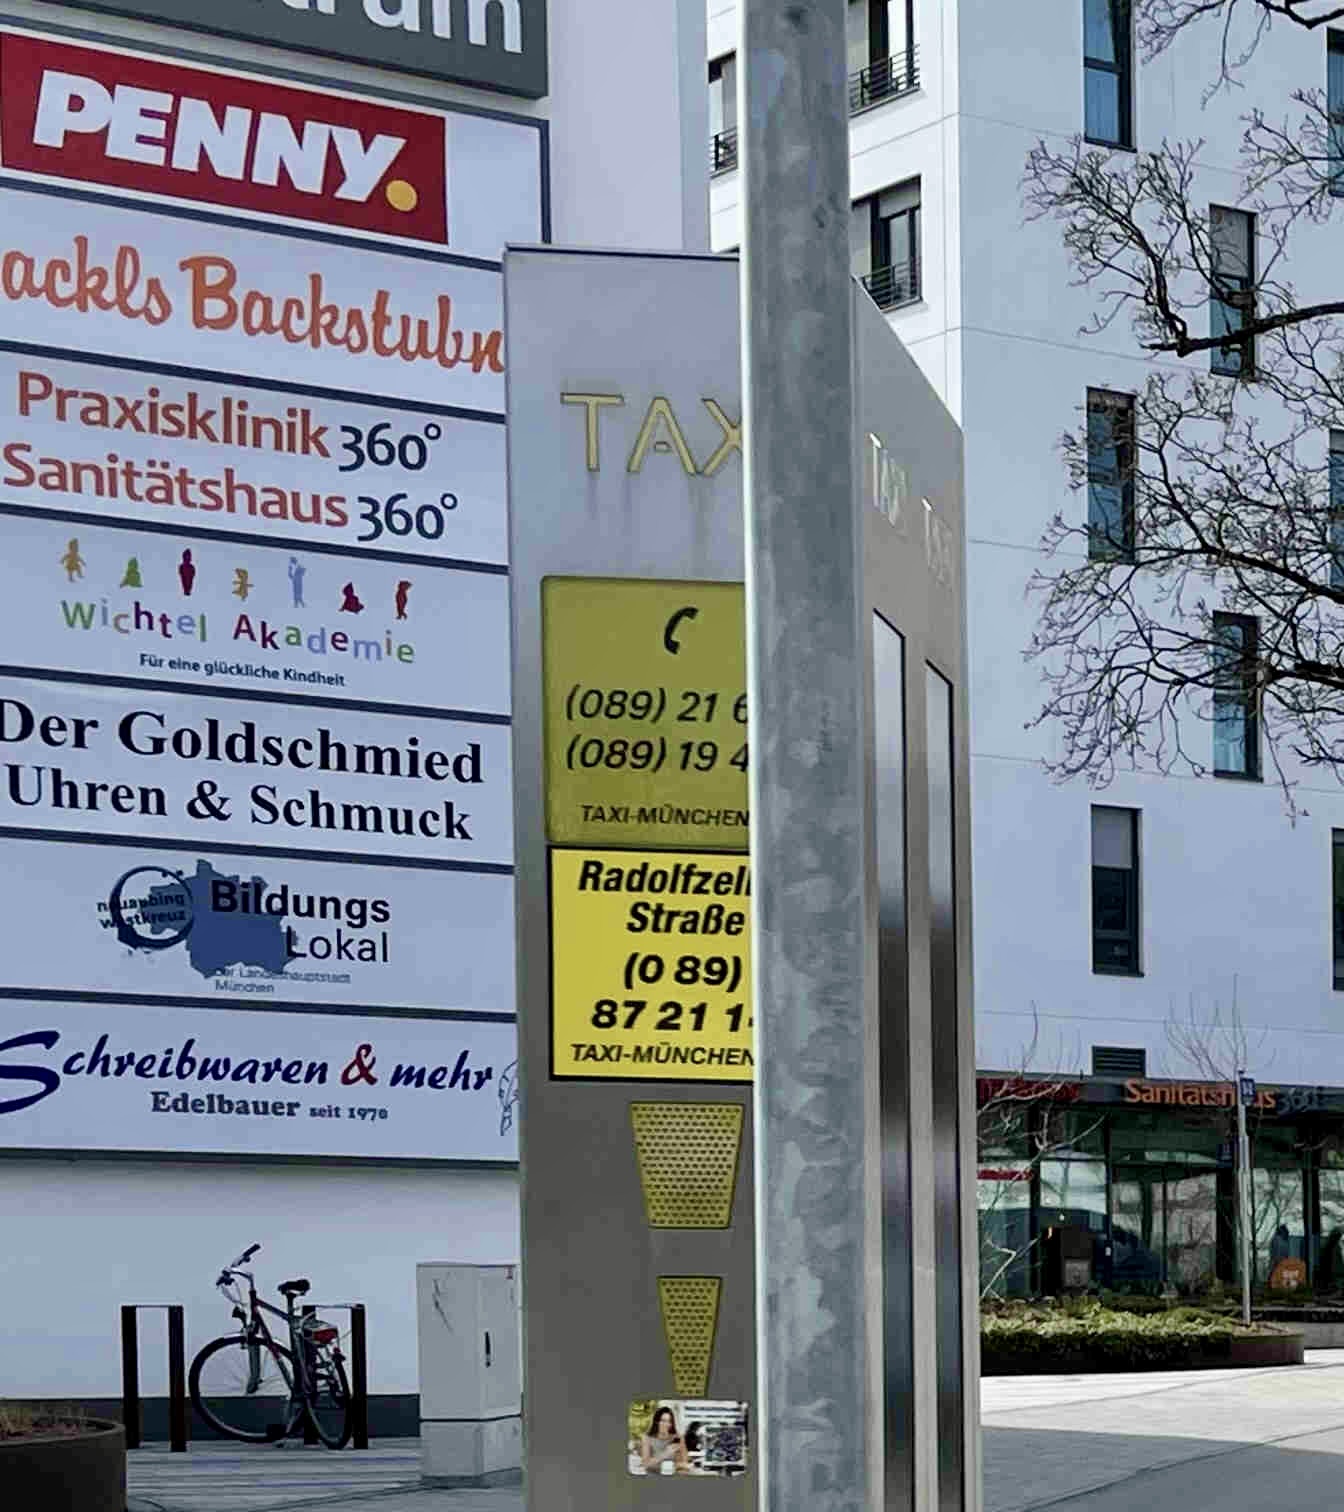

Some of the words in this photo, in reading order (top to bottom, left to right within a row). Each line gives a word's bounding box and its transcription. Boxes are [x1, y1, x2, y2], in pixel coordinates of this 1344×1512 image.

[18, 371, 331, 458] Praxisklinik
[338, 422, 441, 472] 360°
[3, 442, 349, 527] Sanitätshaus
[357, 493, 458, 541] 360°
[60, 599, 207, 643] Wichtel
[233, 614, 414, 664] Akademie
[139, 653, 164, 669] Für
[168, 657, 200, 673] eine
[204, 661, 280, 682] glückliche
[283, 667, 345, 686] Kindheit
[566, 684, 667, 723] (089)
[677, 691, 719, 723] 21
[0, 698, 99, 749] Der
[118, 711, 484, 783] Goldschmied
[566, 735, 667, 774] (089)
[680, 741, 718, 772] 19
[4, 763, 168, 817] Uhren
[186, 780, 232, 822] &
[250, 784, 473, 840] Schmuck
[581, 804, 750, 827] TAXI-MÜNCHEN
[211, 880, 390, 928] Bildungs
[627, 902, 745, 936] Straße
[286, 926, 389, 963] Lokal
[591, 1000, 646, 1030] 87
[655, 1000, 707, 1032] 21
[725, 1003, 753, 1033] 1
[0, 1030, 329, 1115] Schreibwaren
[341, 1043, 378, 1086] &
[390, 1050, 493, 1090] mehr
[151, 1091, 301, 1117] Edelbauer
[309, 1104, 341, 1119] seit
[347, 1105, 389, 1121] 1970
